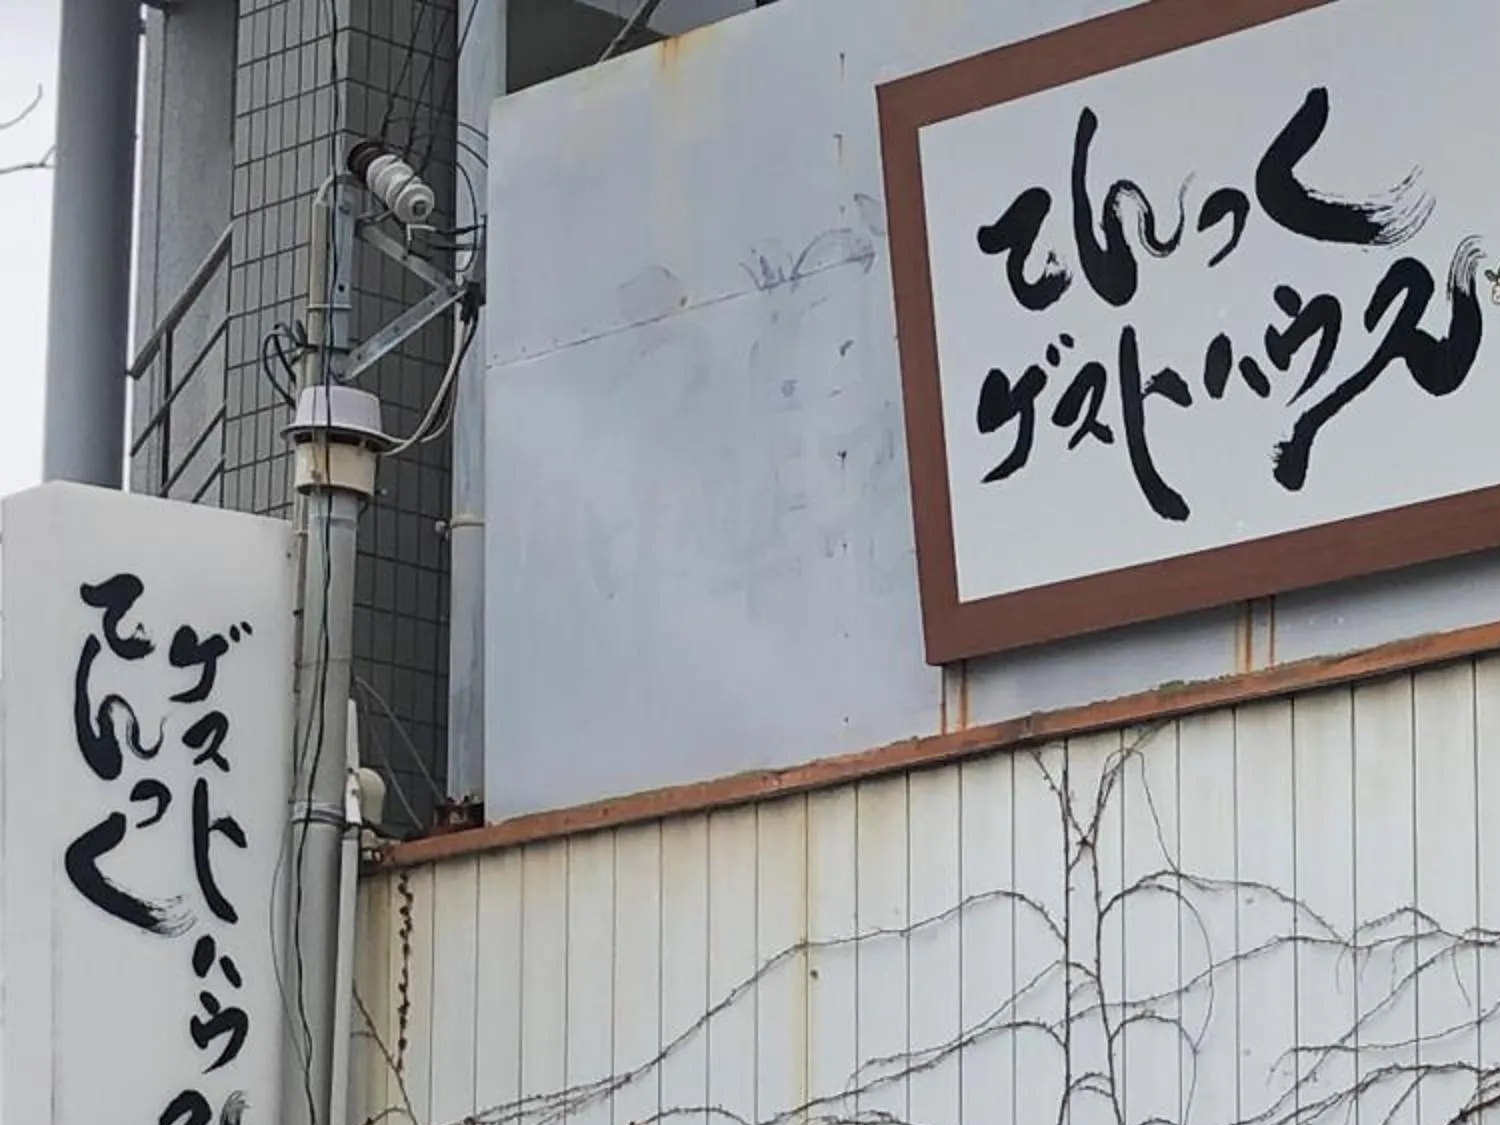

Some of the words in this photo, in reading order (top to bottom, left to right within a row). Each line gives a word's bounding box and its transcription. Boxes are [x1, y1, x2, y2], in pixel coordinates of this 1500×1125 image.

[977, 233, 1485, 522] ゲストハウス
